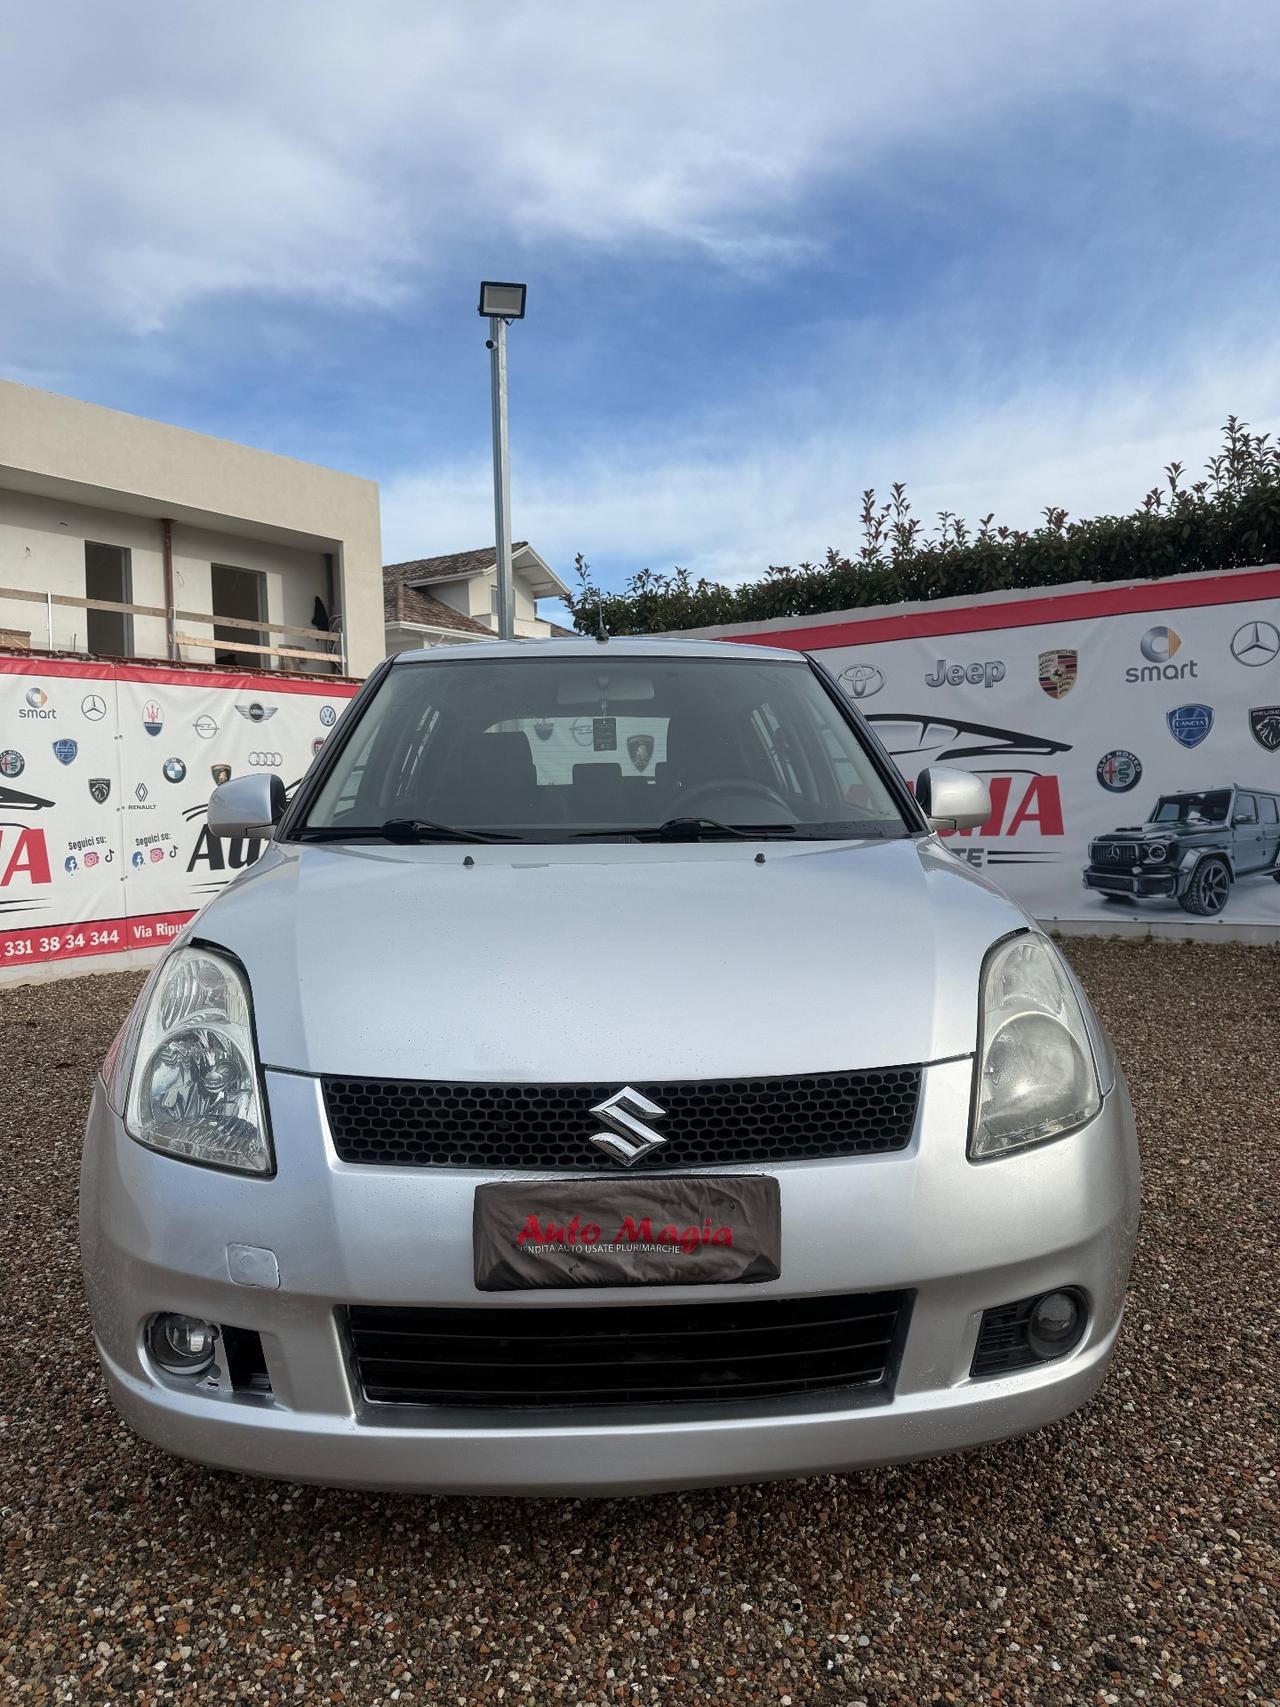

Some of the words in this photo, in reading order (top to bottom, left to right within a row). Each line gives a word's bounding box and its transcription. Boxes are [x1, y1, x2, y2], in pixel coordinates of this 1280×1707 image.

[925, 659, 1006, 688] Jeep
[1125, 660, 1198, 683] smart
[18, 708, 57, 719] smart
[68, 837, 95, 851] Seguici
[95, 835, 107, 843] su:
[135, 833, 161, 847] Seguici
[161, 832, 171, 840] su:
[133, 925, 152, 939] Via
[4, 939, 33, 957] 331
[39, 936, 60, 952] 38
[65, 933, 85, 949] 34
[90, 929, 119, 946] 344
[516, 1215, 601, 1245] Auto
[613, 1215, 734, 1256] Magia
[585, 1243, 614, 1254] USATE
[616, 1243, 680, 1254] PLURIMARCHE
